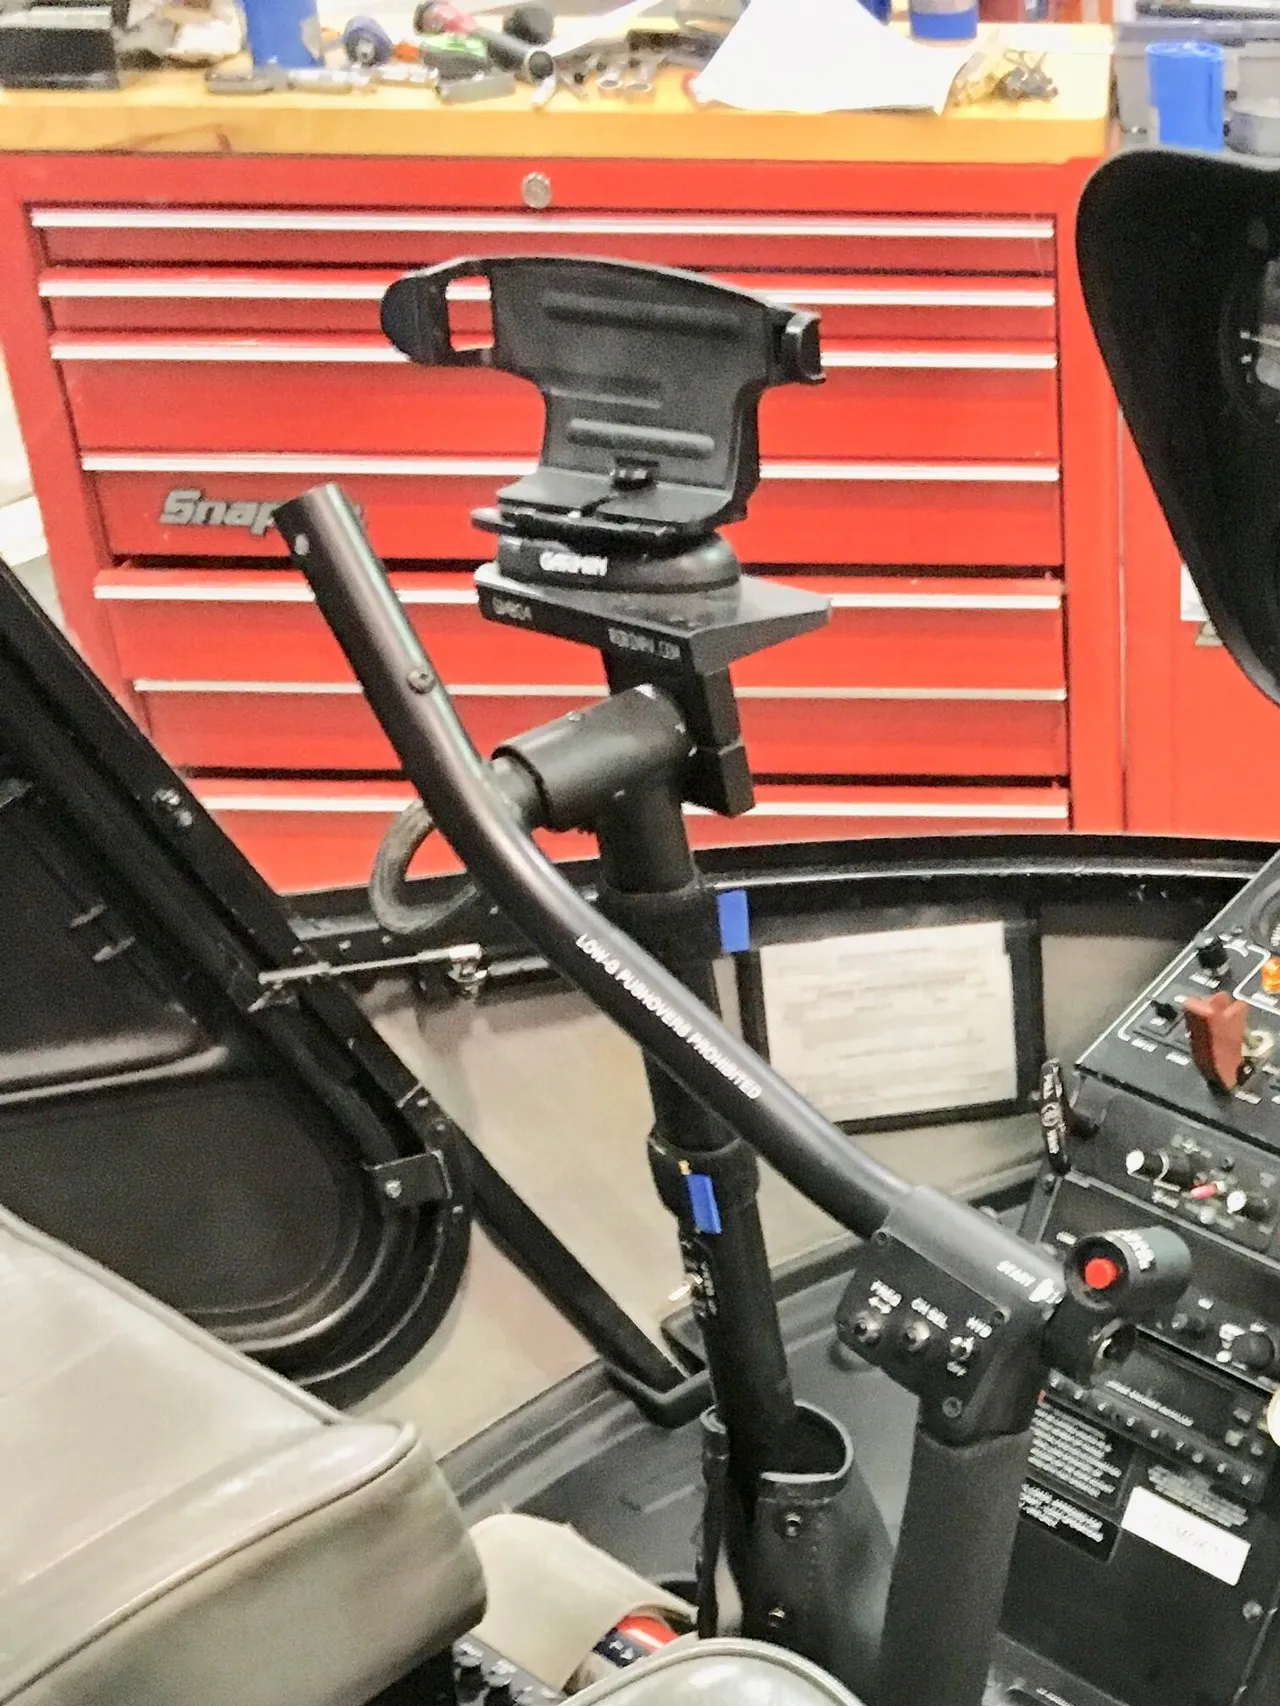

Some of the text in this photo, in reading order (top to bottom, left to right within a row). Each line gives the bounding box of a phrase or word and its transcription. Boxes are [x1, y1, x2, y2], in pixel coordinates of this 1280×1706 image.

[575, 933, 763, 1100] LOW-G PUSHOVERS PROHIBITED
